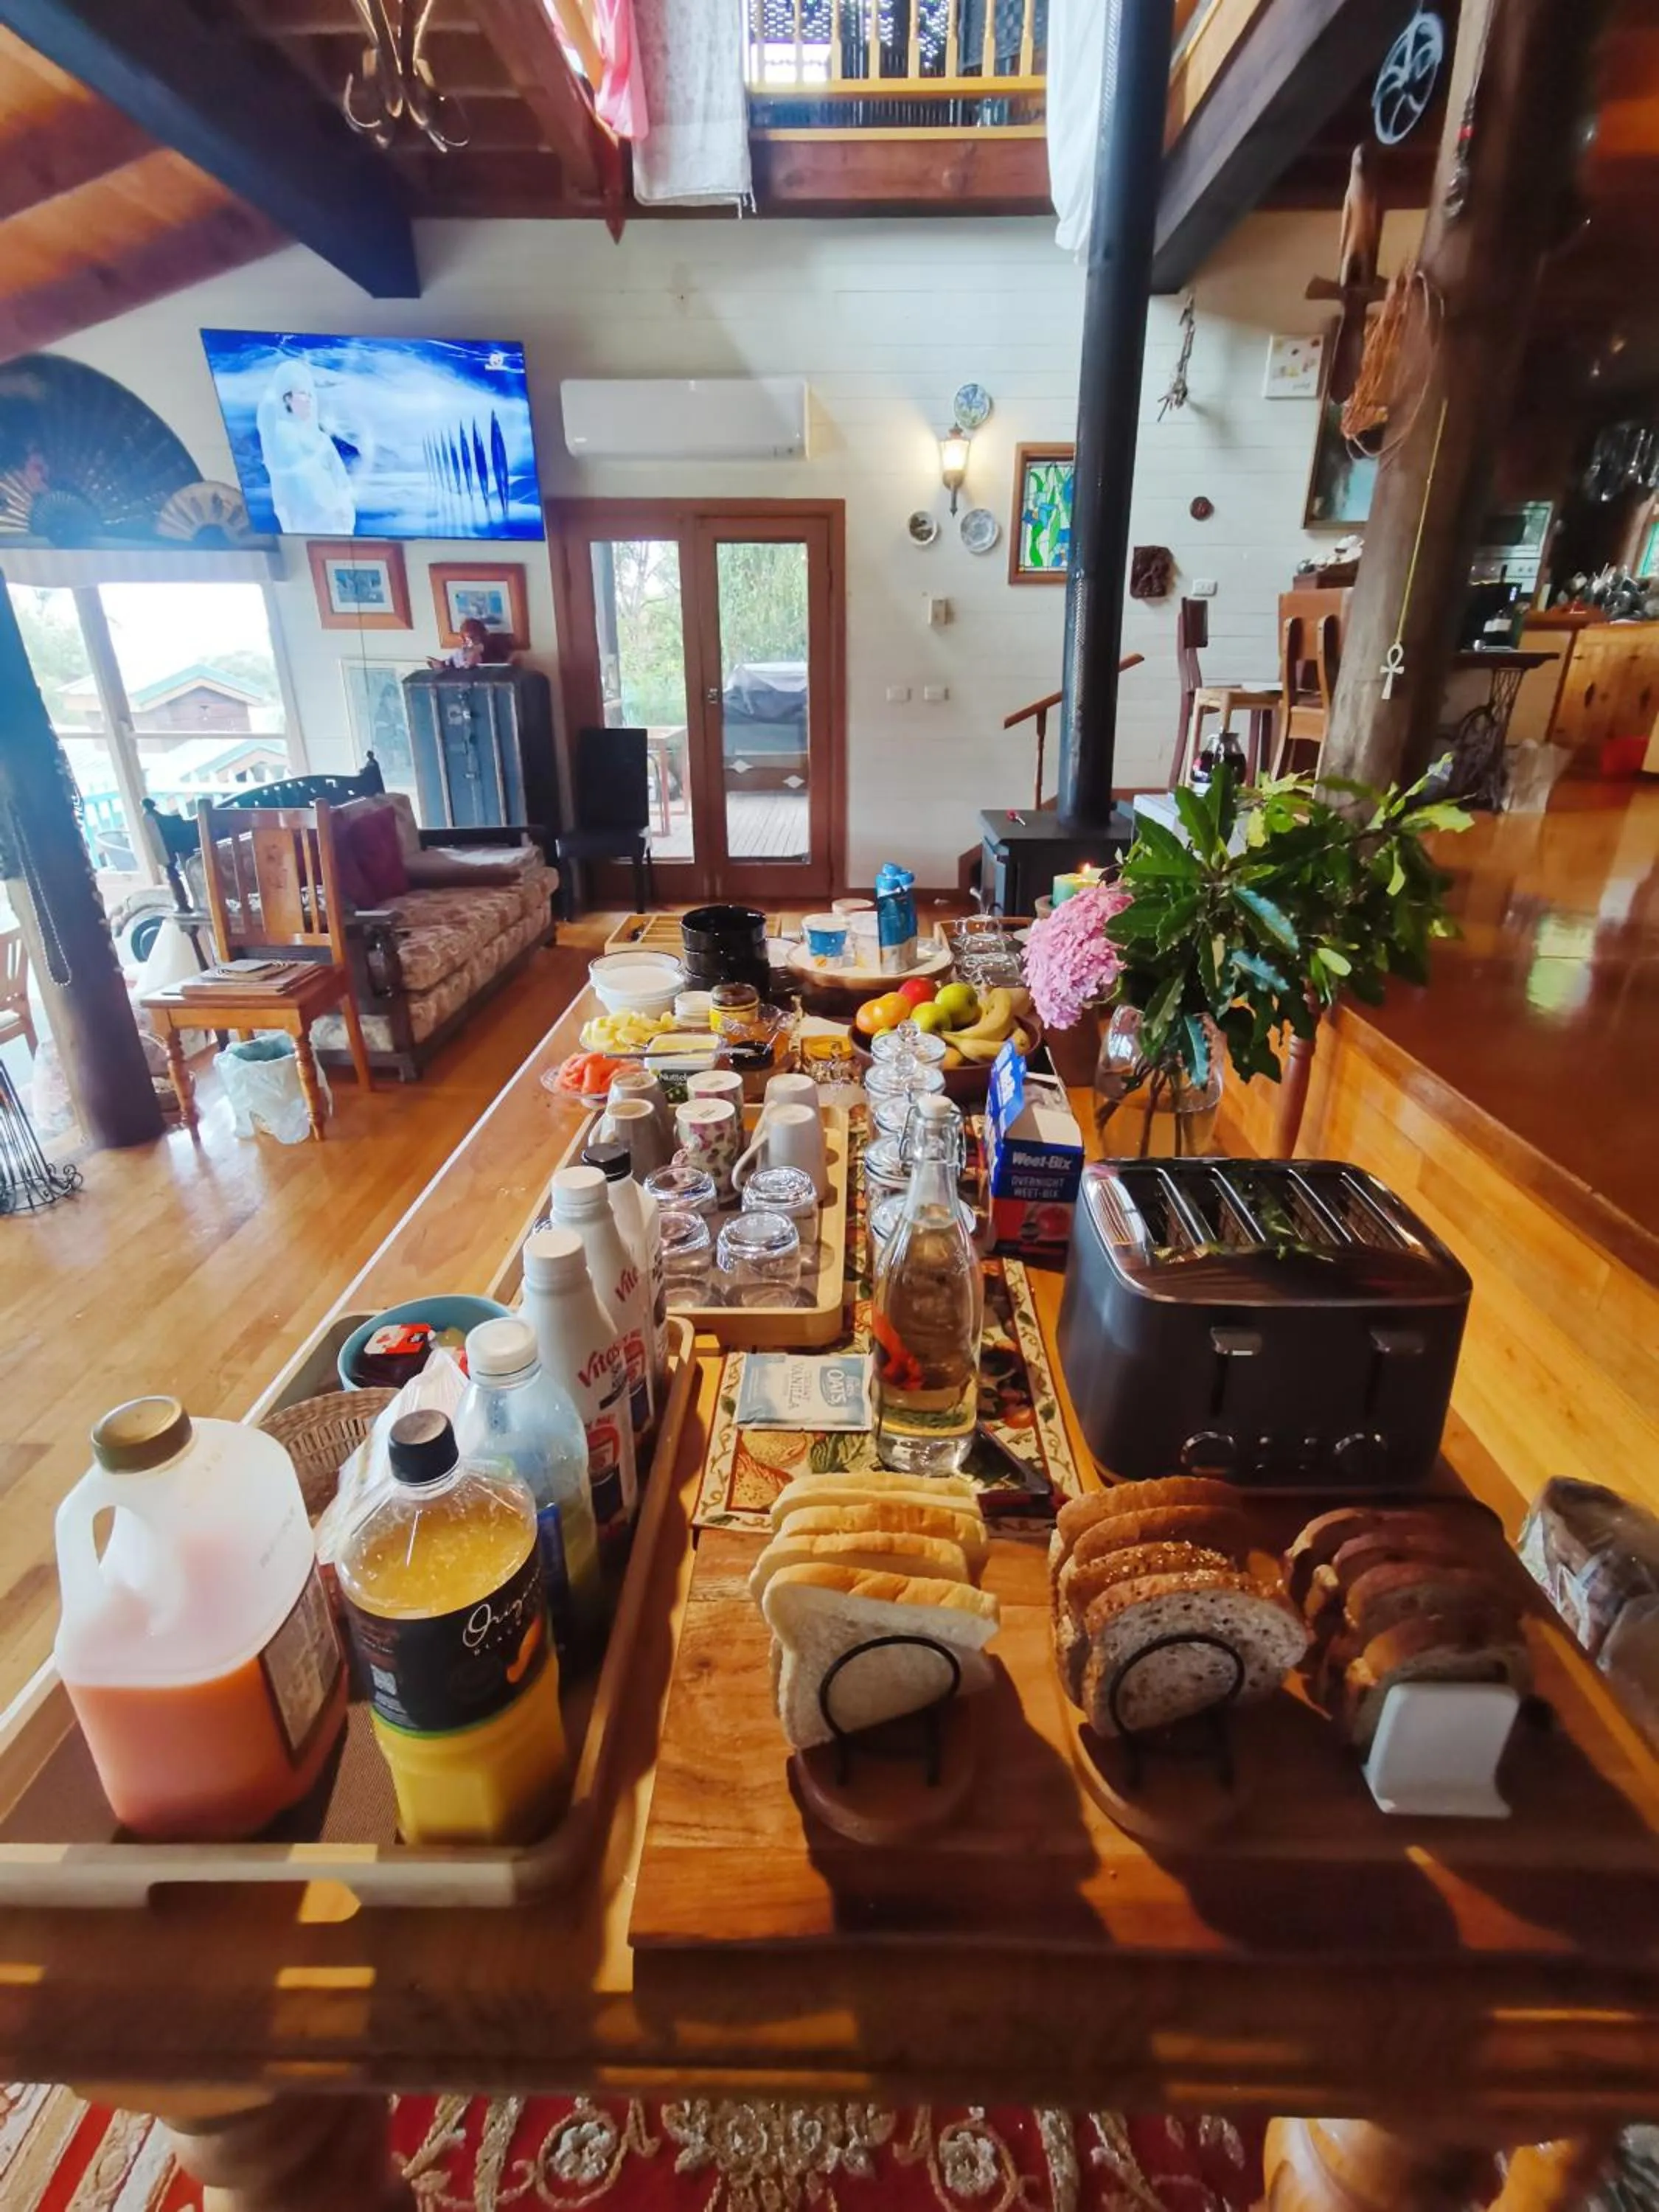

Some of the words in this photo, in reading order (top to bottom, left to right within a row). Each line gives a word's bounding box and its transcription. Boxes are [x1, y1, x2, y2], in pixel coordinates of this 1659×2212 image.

[659, 1073, 686, 1082] Nuttel
[1012, 1152, 1071, 1170] Weet-Bix
[788, 1363, 804, 1410] VANILLA
[827, 1368, 846, 1405] OATS
